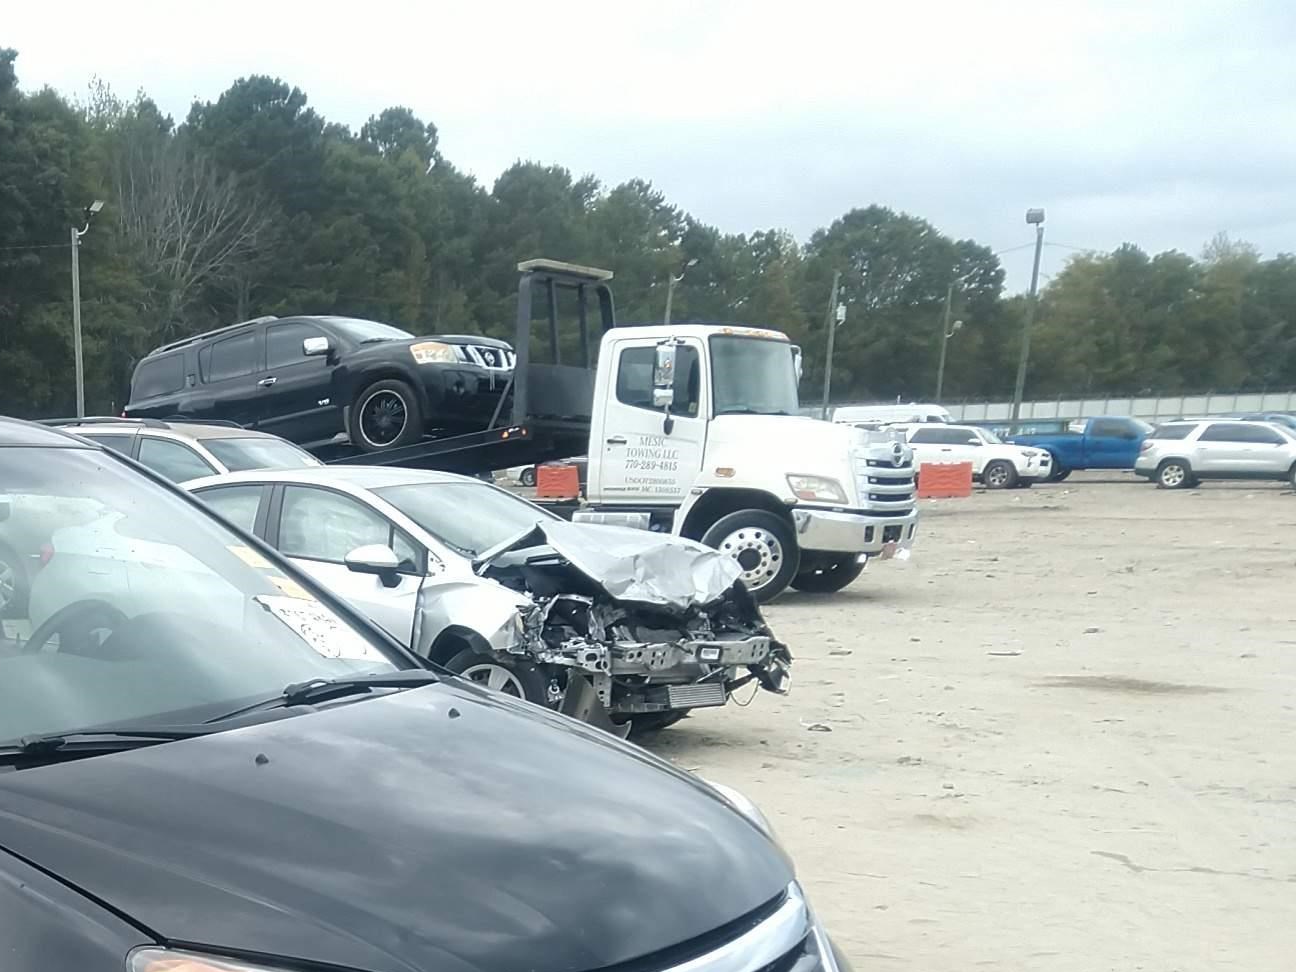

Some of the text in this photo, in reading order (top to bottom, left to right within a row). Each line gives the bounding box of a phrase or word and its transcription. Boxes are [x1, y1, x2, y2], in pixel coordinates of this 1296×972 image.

[626, 447, 679, 460] TOWING LLC
[625, 459, 678, 471] 770-289-4815
